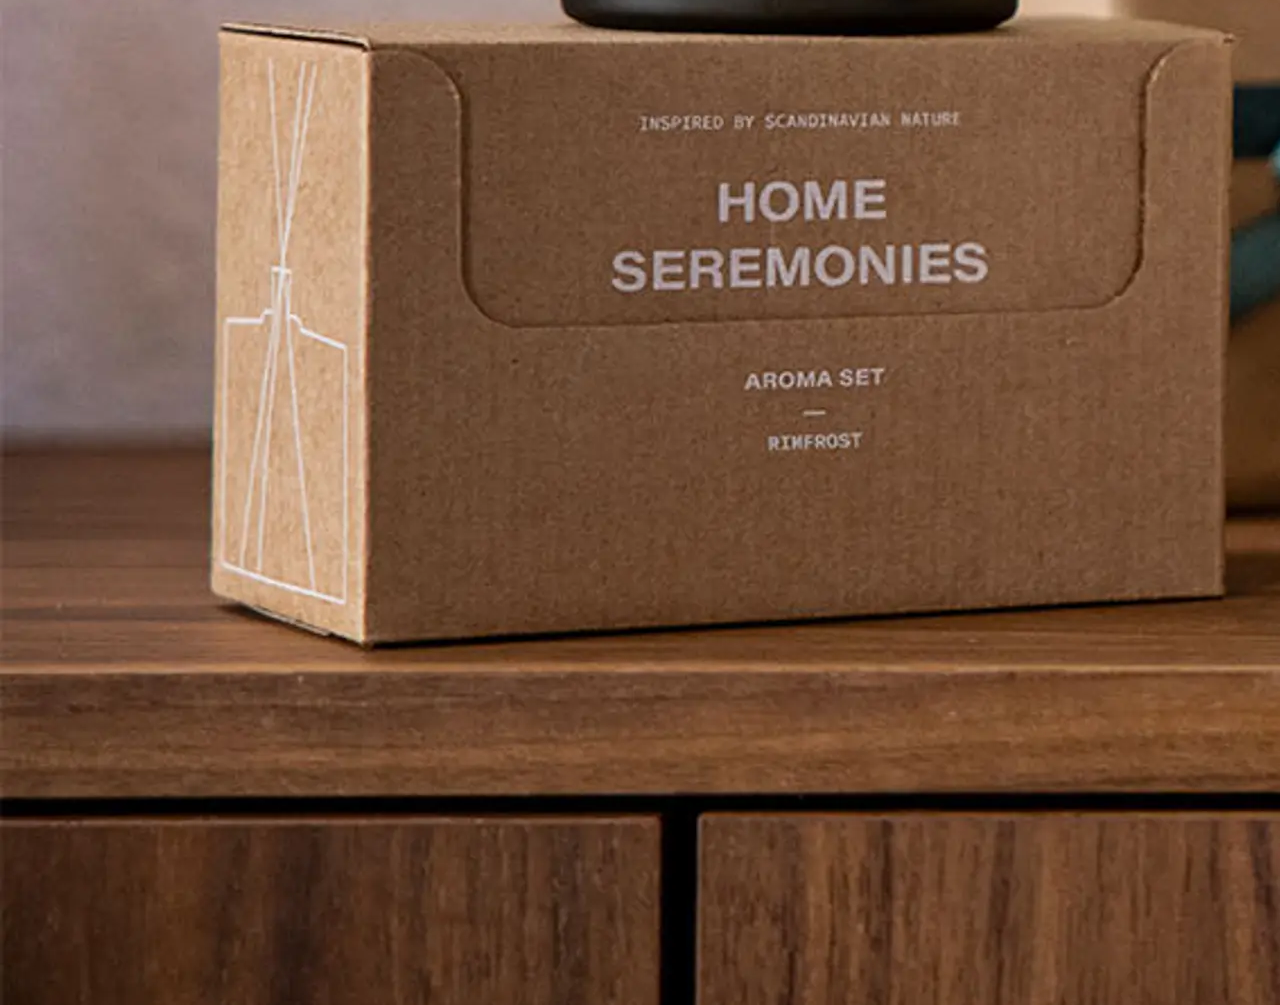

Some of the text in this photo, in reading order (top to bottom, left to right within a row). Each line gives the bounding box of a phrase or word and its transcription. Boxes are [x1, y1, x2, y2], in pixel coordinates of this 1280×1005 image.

[640, 112, 961, 131] INSPIRED BY SCANDINAVIAN NATURE
[718, 179, 887, 223] HOME
[611, 243, 988, 292] SEREMONIES
[745, 369, 884, 390] AROMA SET
[768, 433, 863, 450] RIMFROST
